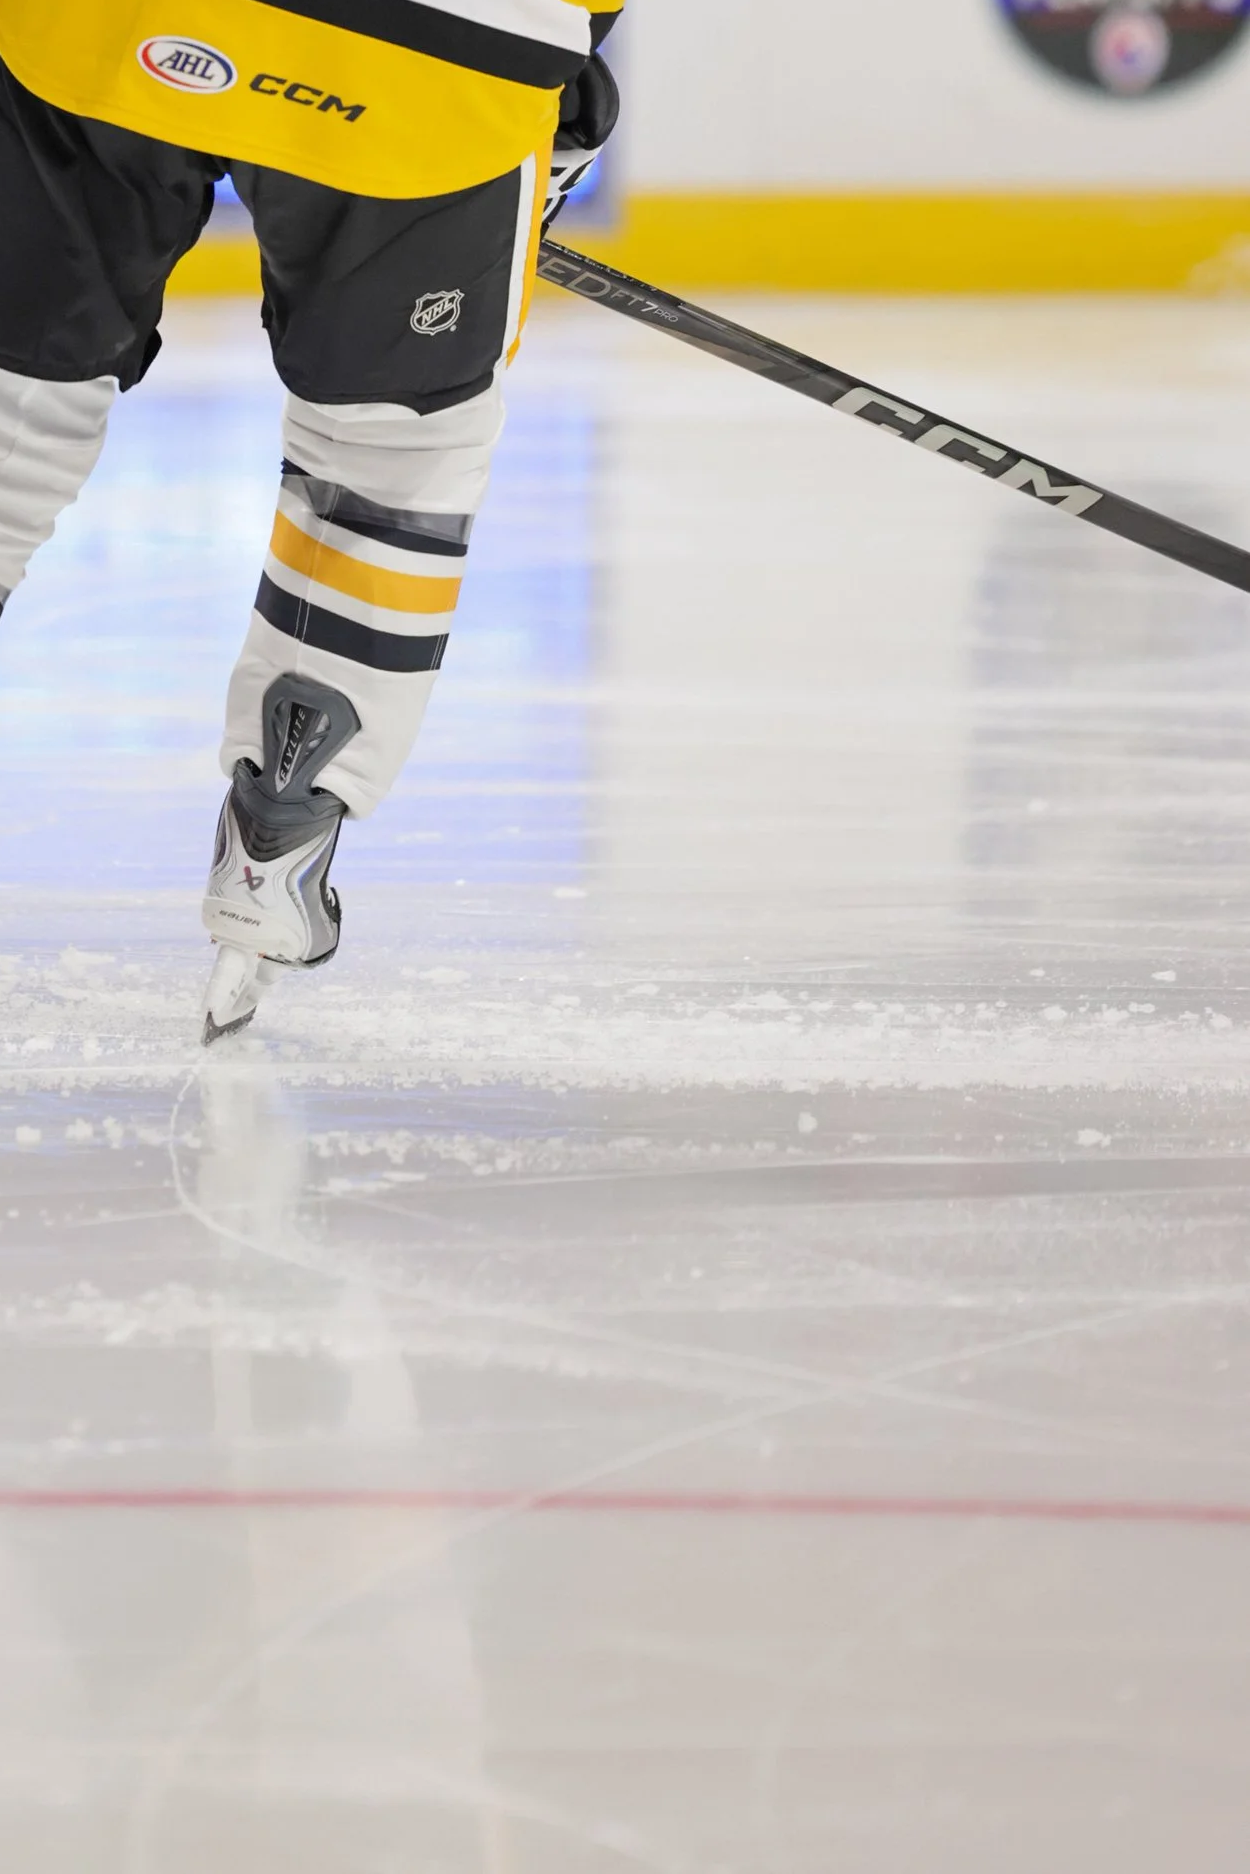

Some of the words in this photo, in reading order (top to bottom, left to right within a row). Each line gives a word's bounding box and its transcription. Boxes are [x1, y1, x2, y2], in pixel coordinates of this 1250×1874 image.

[158, 50, 215, 81] AHL
[249, 73, 367, 123] CCM
[536, 249, 612, 298] ED
[421, 298, 454, 326] NHL
[832, 386, 1104, 517] CCM
[280, 707, 306, 783] FLYLITE
